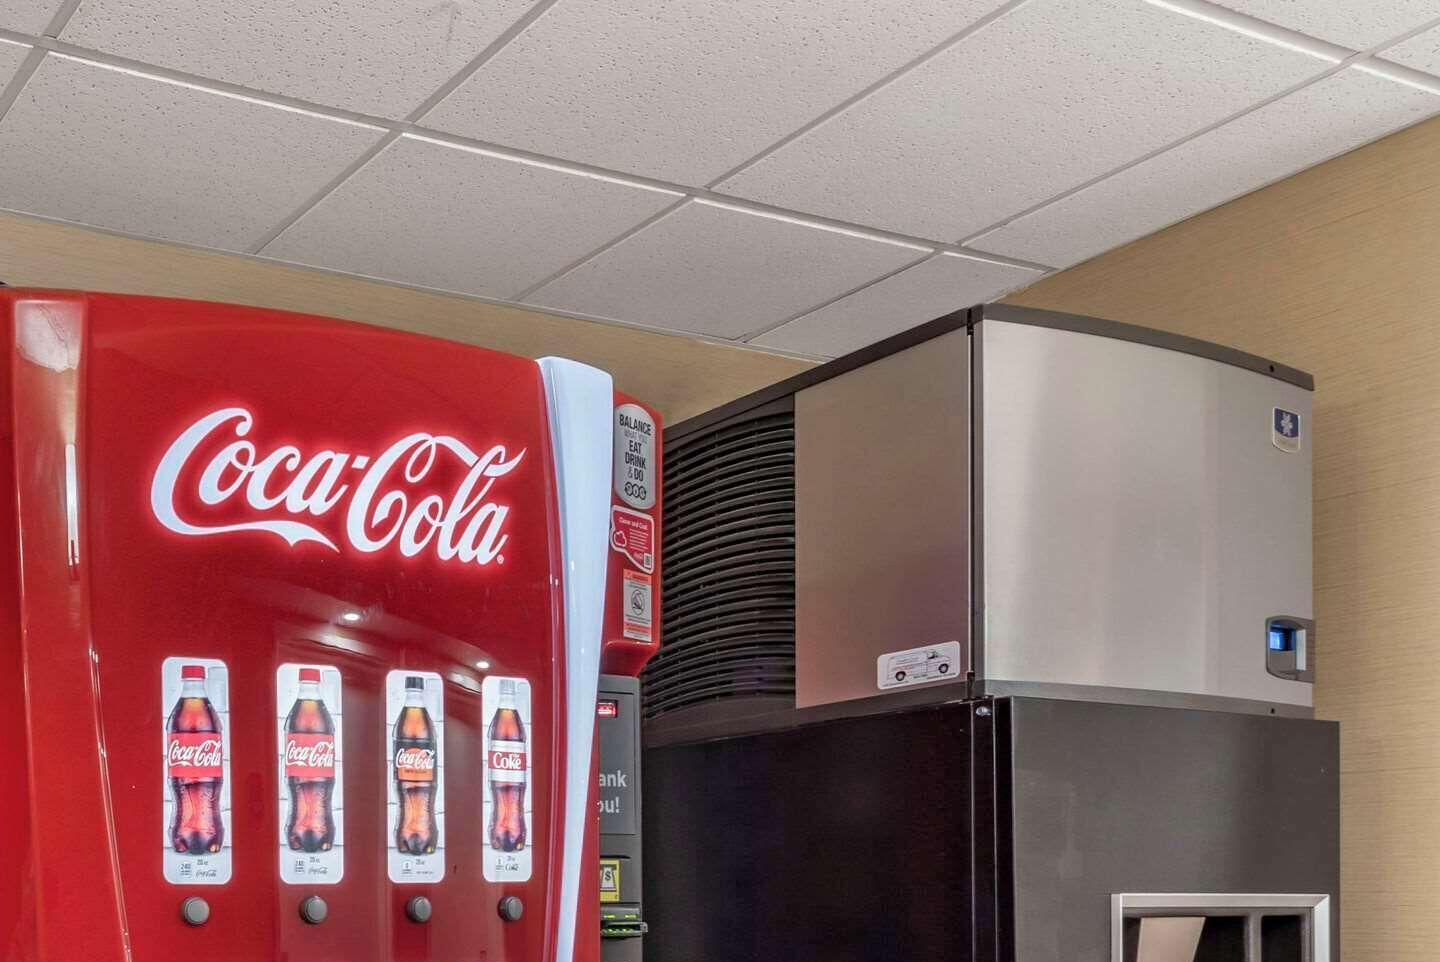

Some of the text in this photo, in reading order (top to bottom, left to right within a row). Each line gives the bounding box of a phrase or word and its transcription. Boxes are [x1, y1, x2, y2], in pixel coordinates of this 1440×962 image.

[619, 413, 652, 437] BALANCE
[628, 439, 643, 452] EAT
[624, 451, 647, 470] DRINK
[150, 406, 527, 566] Coca-Cola
[633, 469, 644, 482] DO
[167, 739, 222, 768] Coca-Cola
[284, 739, 334, 768] Coca-Cola
[395, 747, 436, 770] Coca-Cola
[492, 752, 522, 770] Coke
